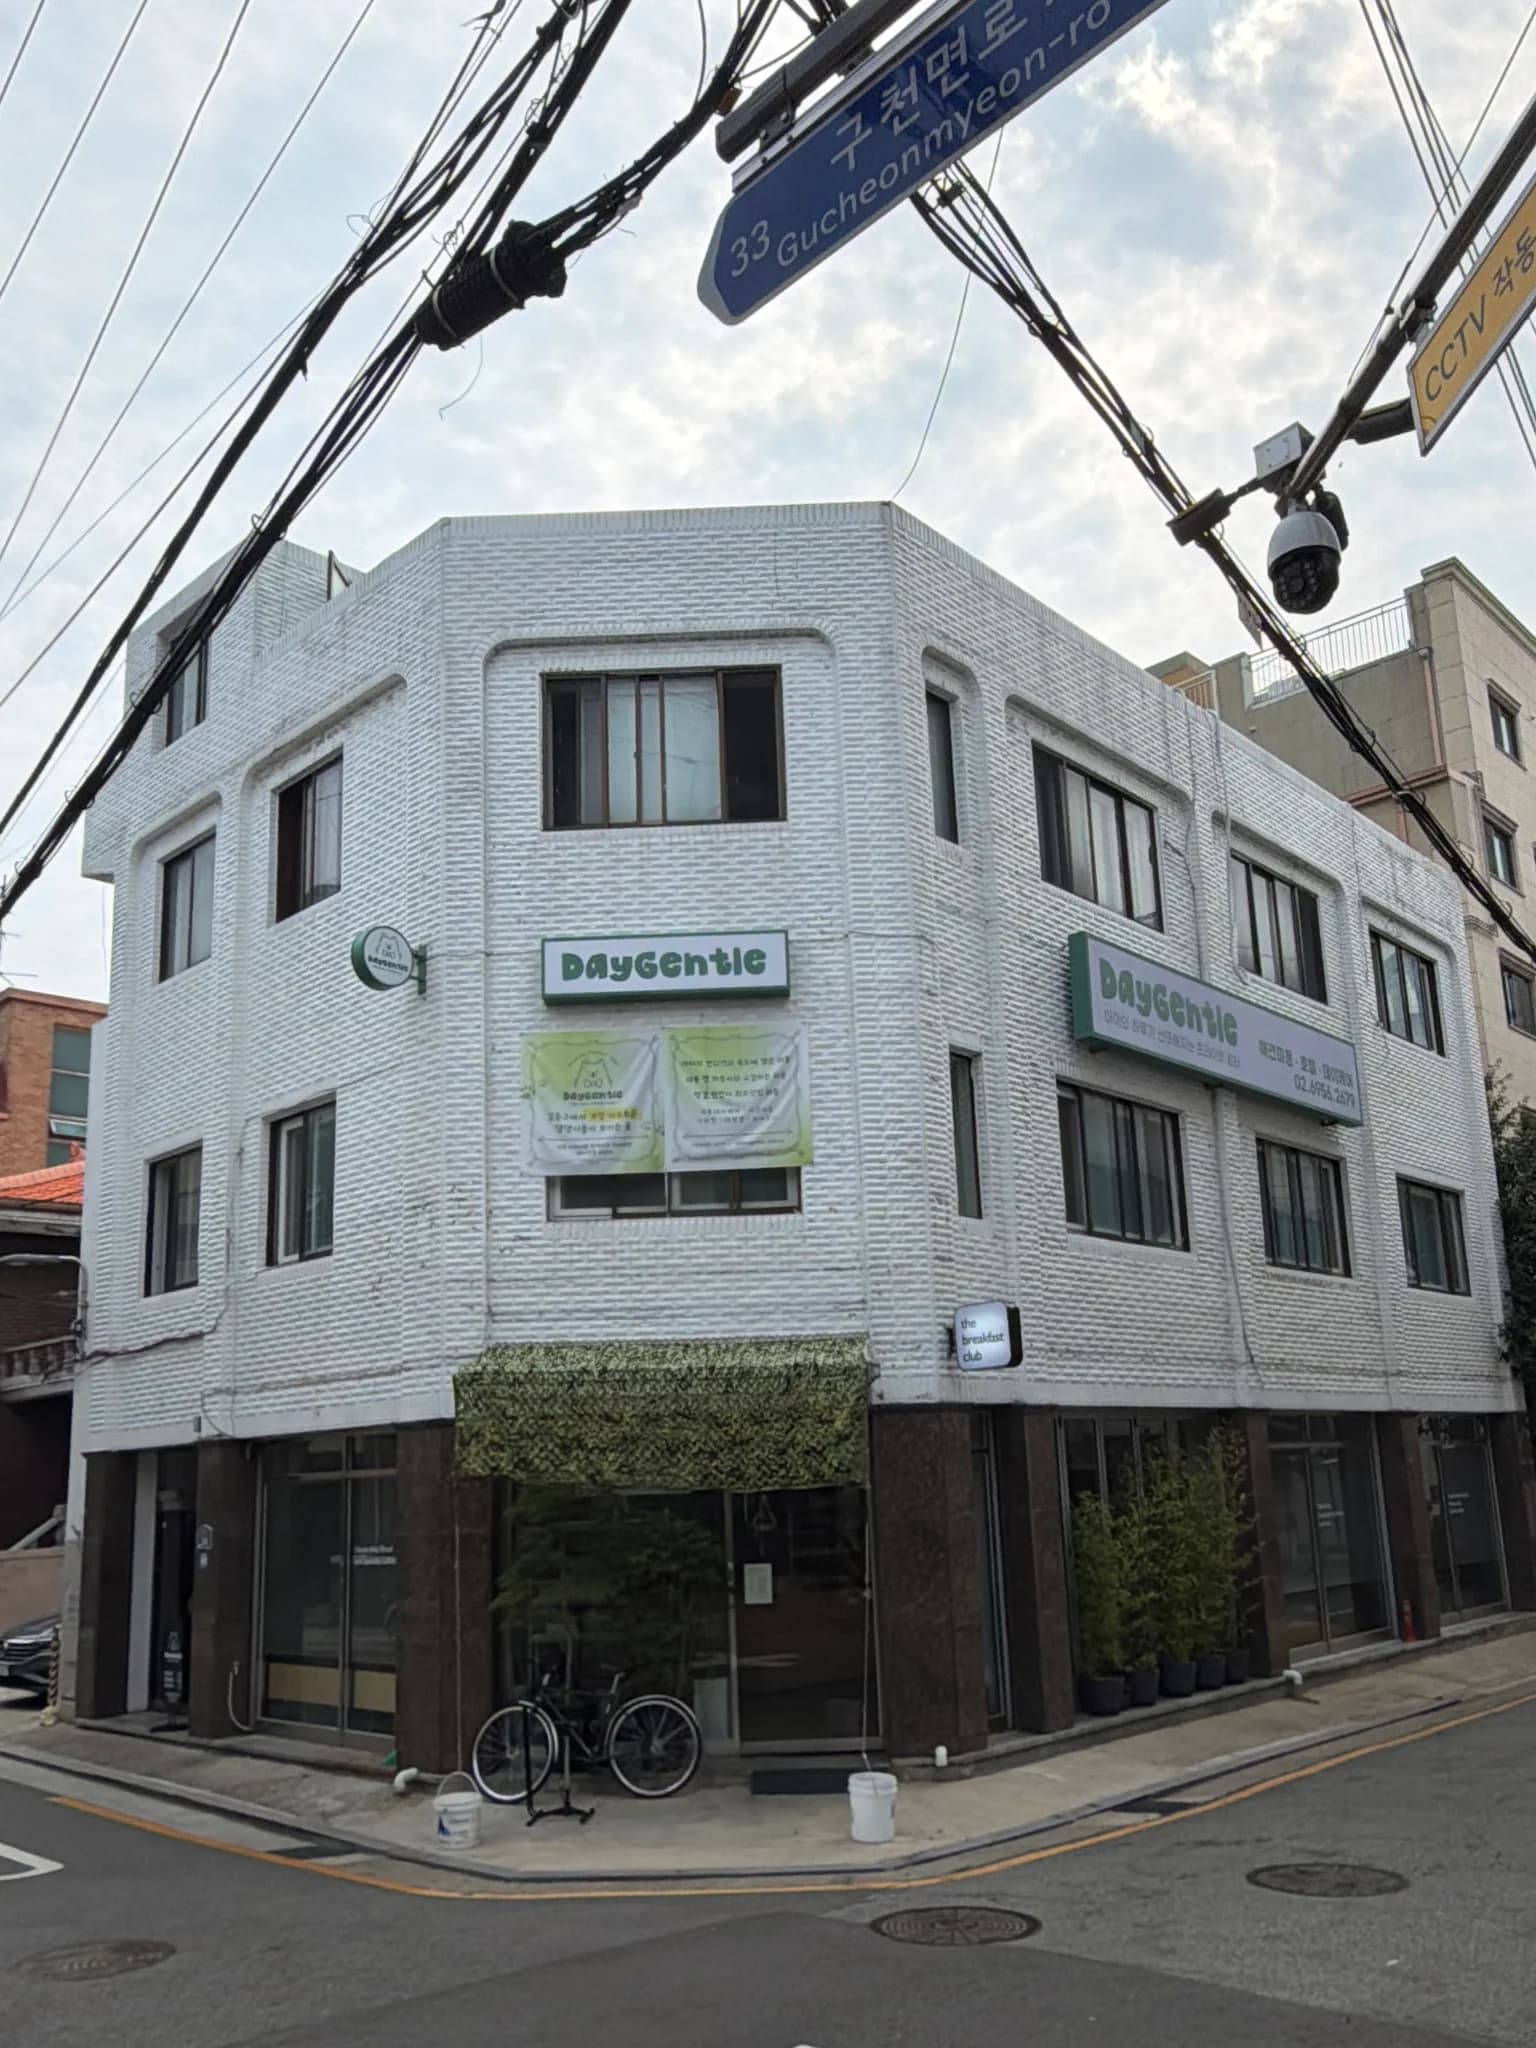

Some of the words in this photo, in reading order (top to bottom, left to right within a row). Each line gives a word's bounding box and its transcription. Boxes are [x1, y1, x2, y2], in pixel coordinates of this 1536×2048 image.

[830, 0, 1028, 172] 구천면로
[777, 0, 1110, 268] Gucheonmyeon-ro
[730, 219, 771, 278] 33
[1425, 293, 1486, 402] CCTV
[961, 1317, 977, 1329] the
[961, 1330, 1005, 1346] breakfast
[962, 1350, 983, 1362] club
